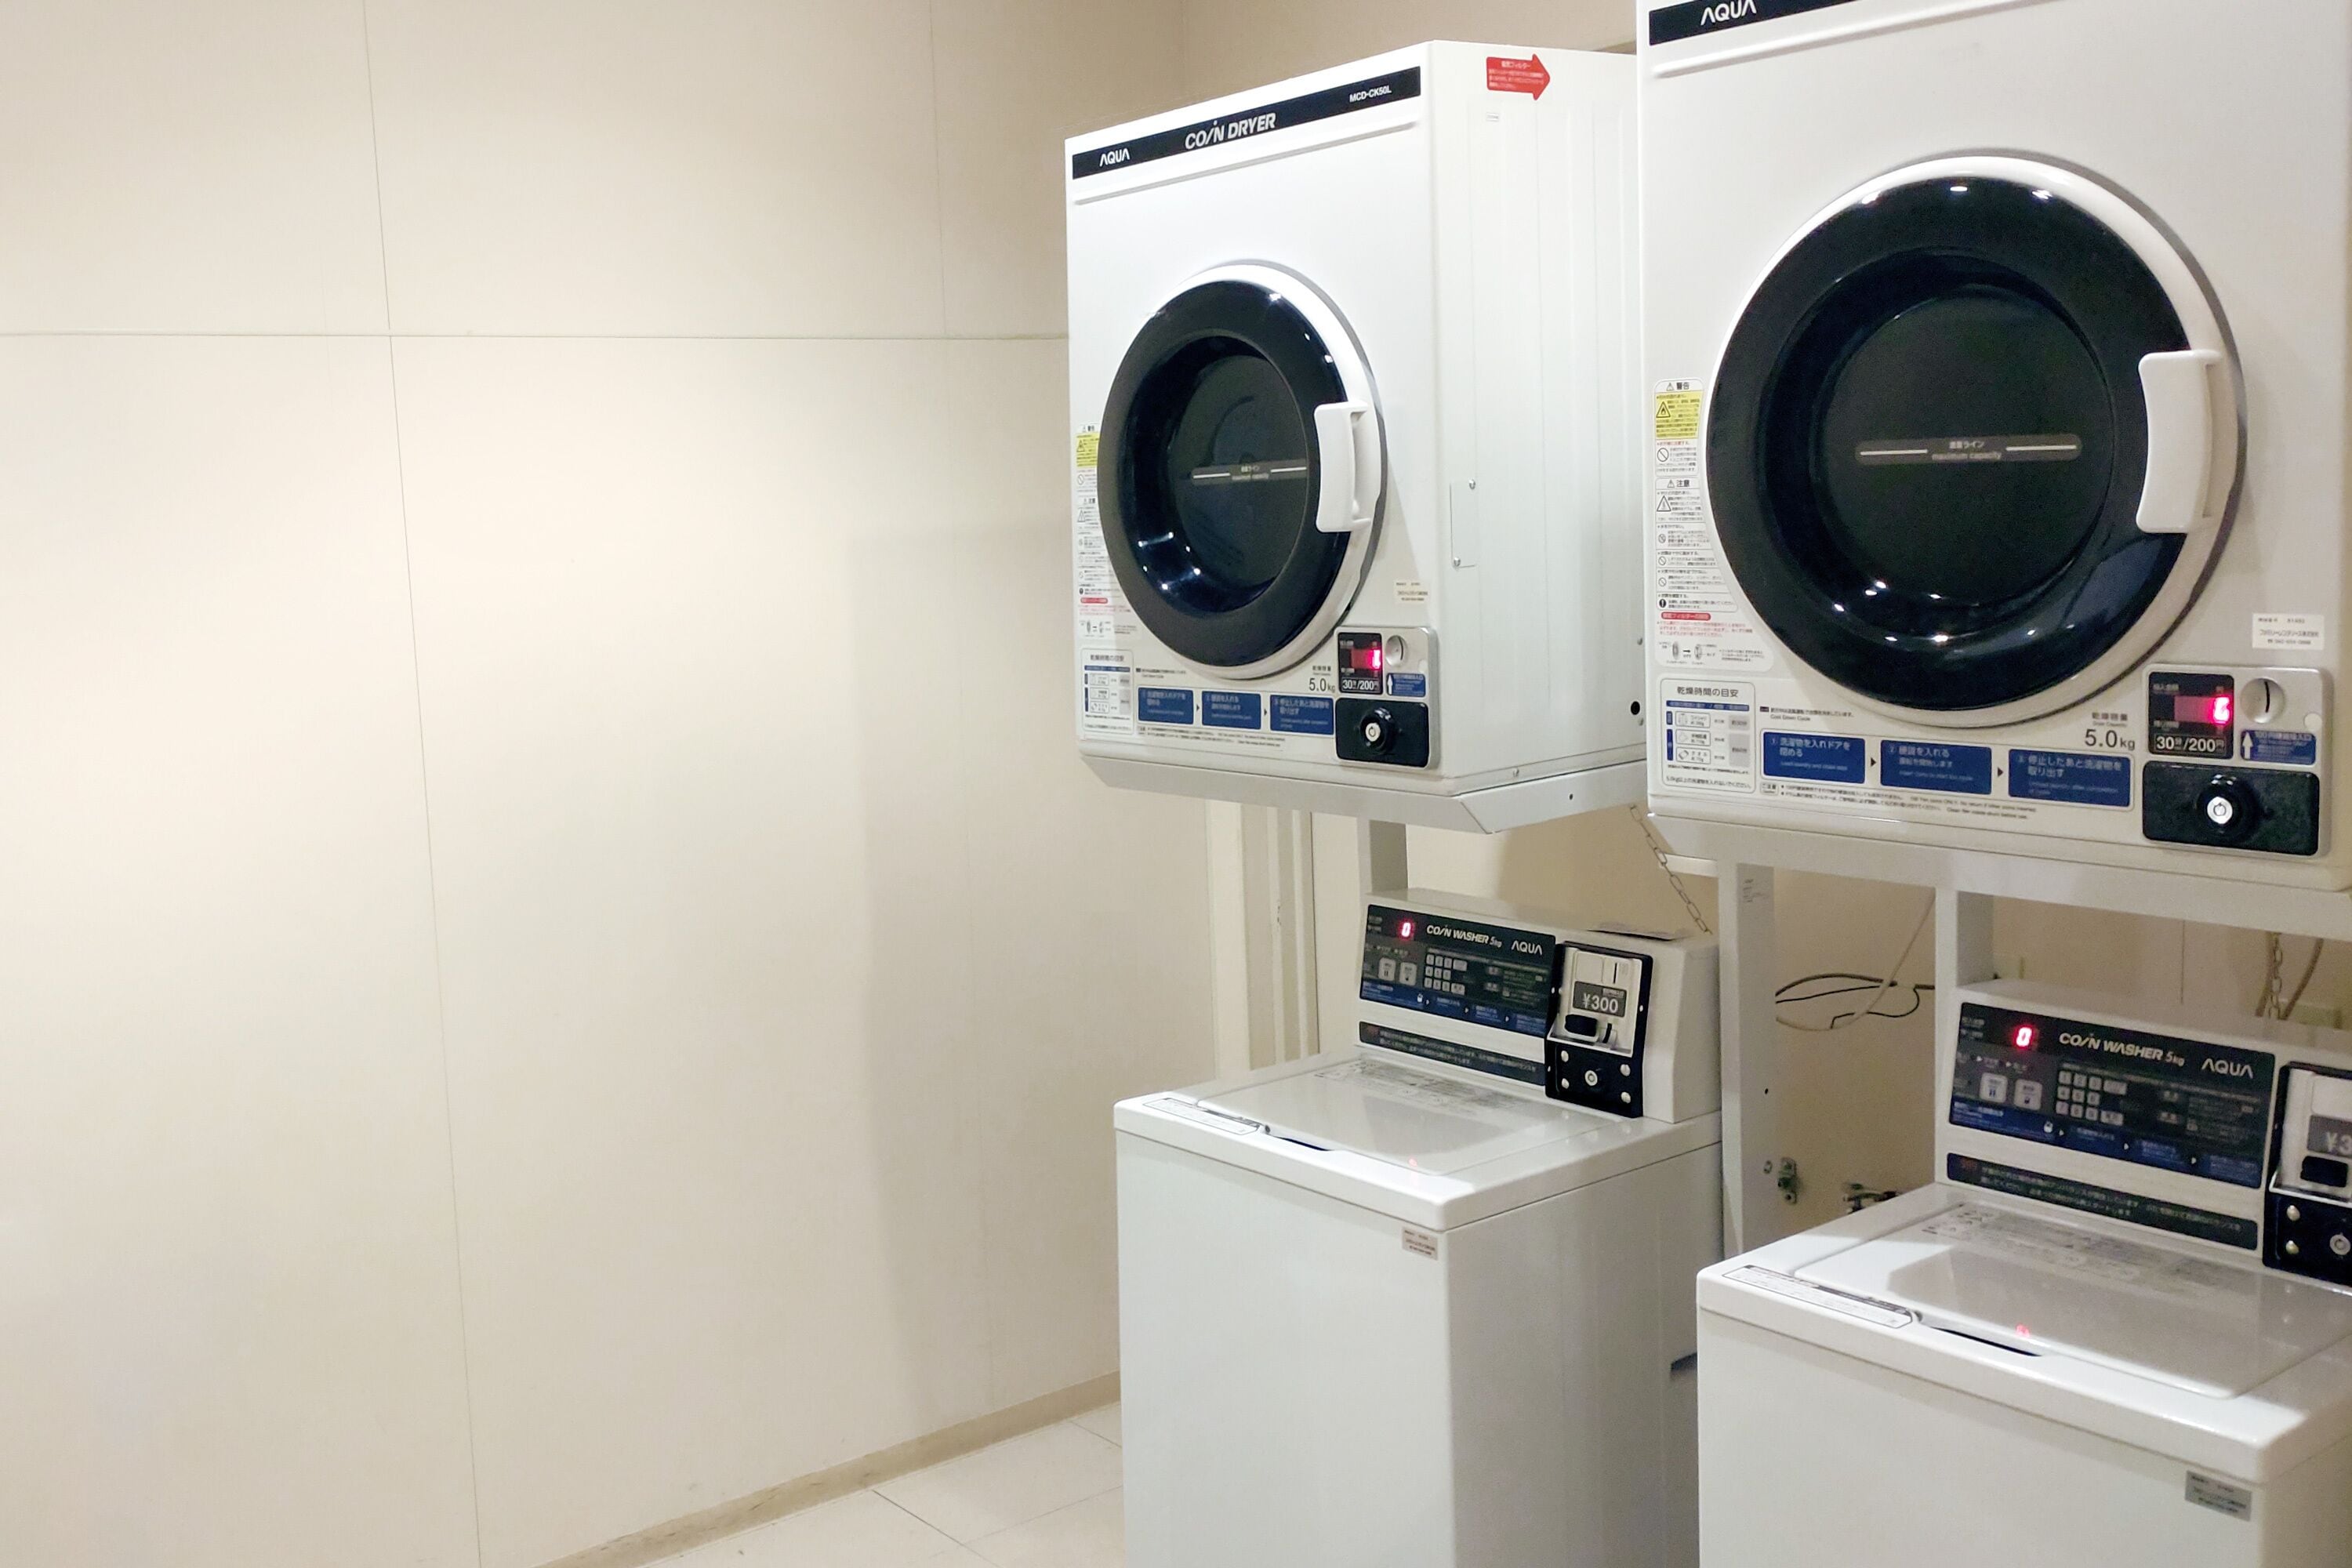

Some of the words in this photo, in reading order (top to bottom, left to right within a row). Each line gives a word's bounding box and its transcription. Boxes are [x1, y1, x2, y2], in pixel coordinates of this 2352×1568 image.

[1700, 0, 1757, 25] AQUA
[1349, 85, 1392, 103] MCD-CK50L
[1228, 112, 1276, 139] DRYER
[1099, 147, 1131, 167] AQUA
[1677, 687, 1739, 697] 乾燥時間の目安
[2085, 728, 2136, 751] 5.0kg
[1401, 922, 1411, 938] 0
[1453, 931, 1490, 944] WASHER
[1511, 940, 1543, 956] AQUA
[1583, 993, 1618, 1013] ¥300
[2016, 1026, 2033, 1047] 0
[2103, 1040, 2164, 1060] WASHER
[2201, 1058, 2254, 1079] AQUA
